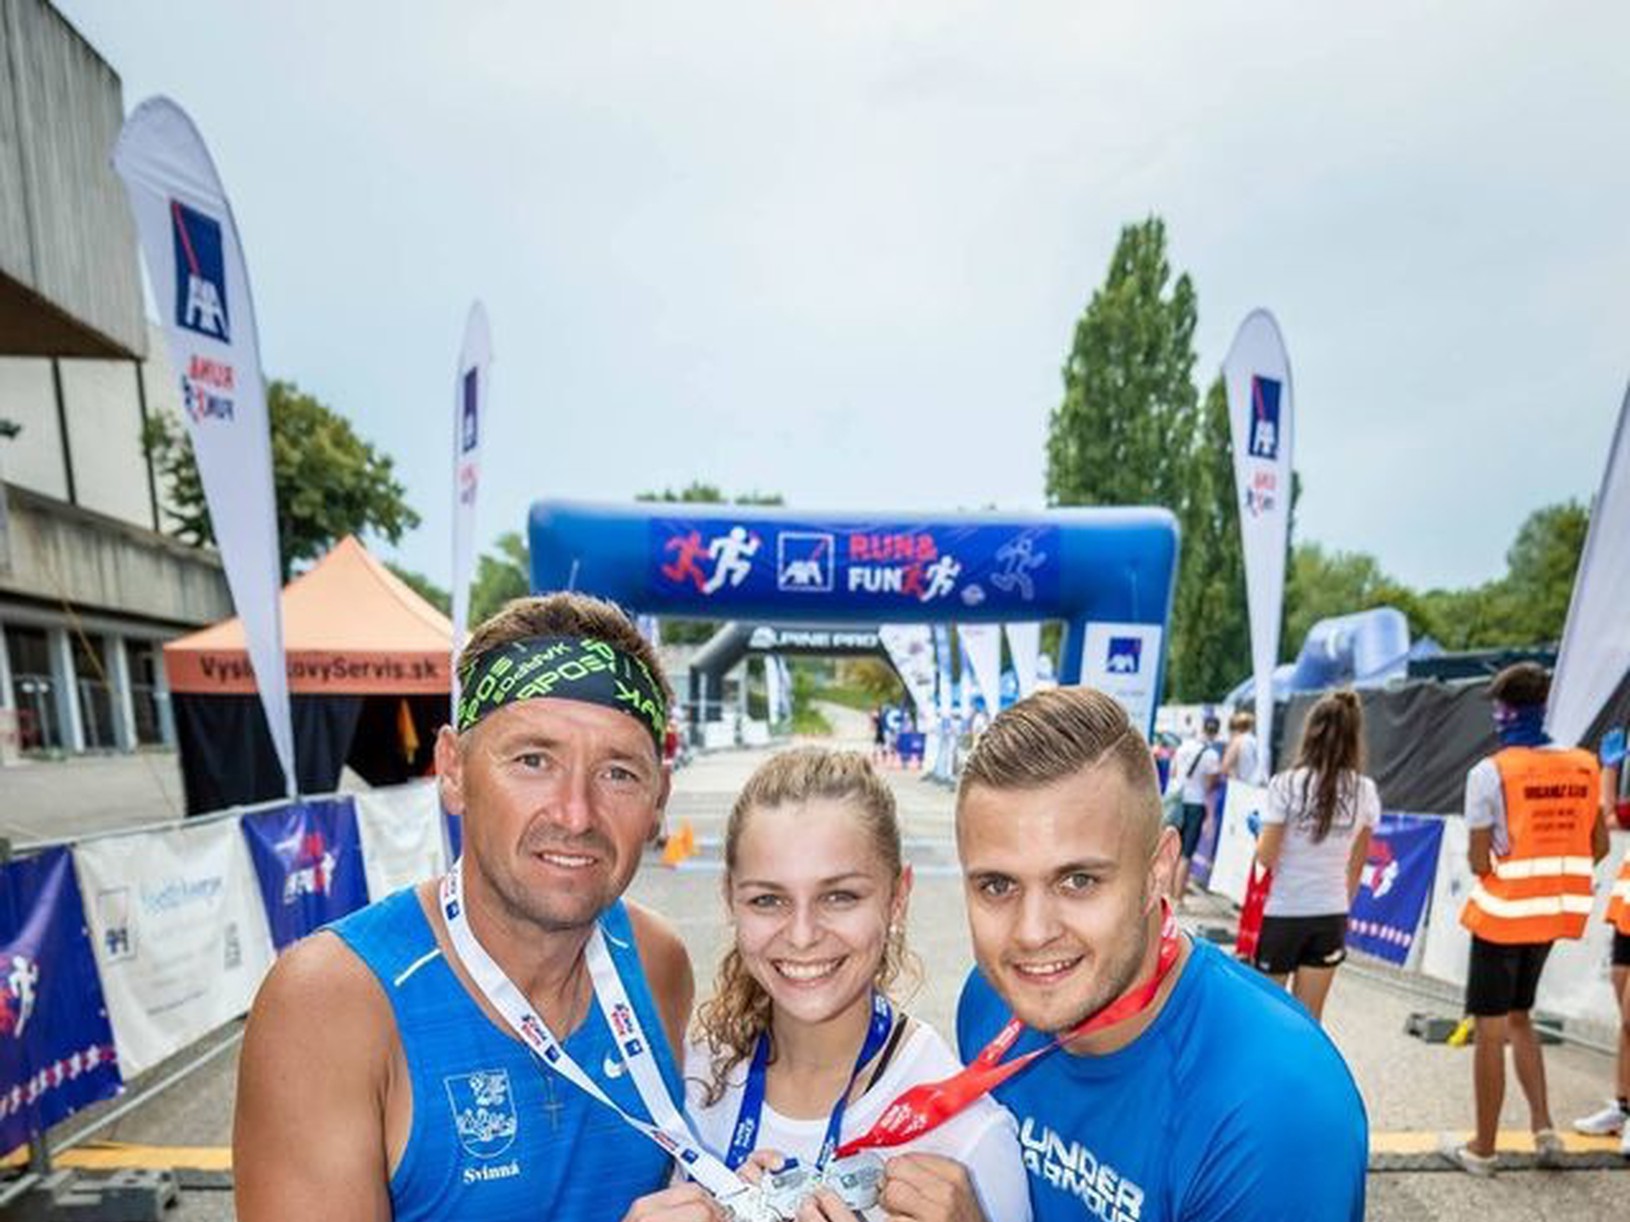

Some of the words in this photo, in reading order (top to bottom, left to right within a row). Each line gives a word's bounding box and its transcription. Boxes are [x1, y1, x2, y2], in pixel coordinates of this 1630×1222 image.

[779, 560, 823, 585] AXA
[848, 567, 902, 592] FUN
[463, 1160, 520, 1185] Svinná
[1020, 1116, 1145, 1220] UNDER
